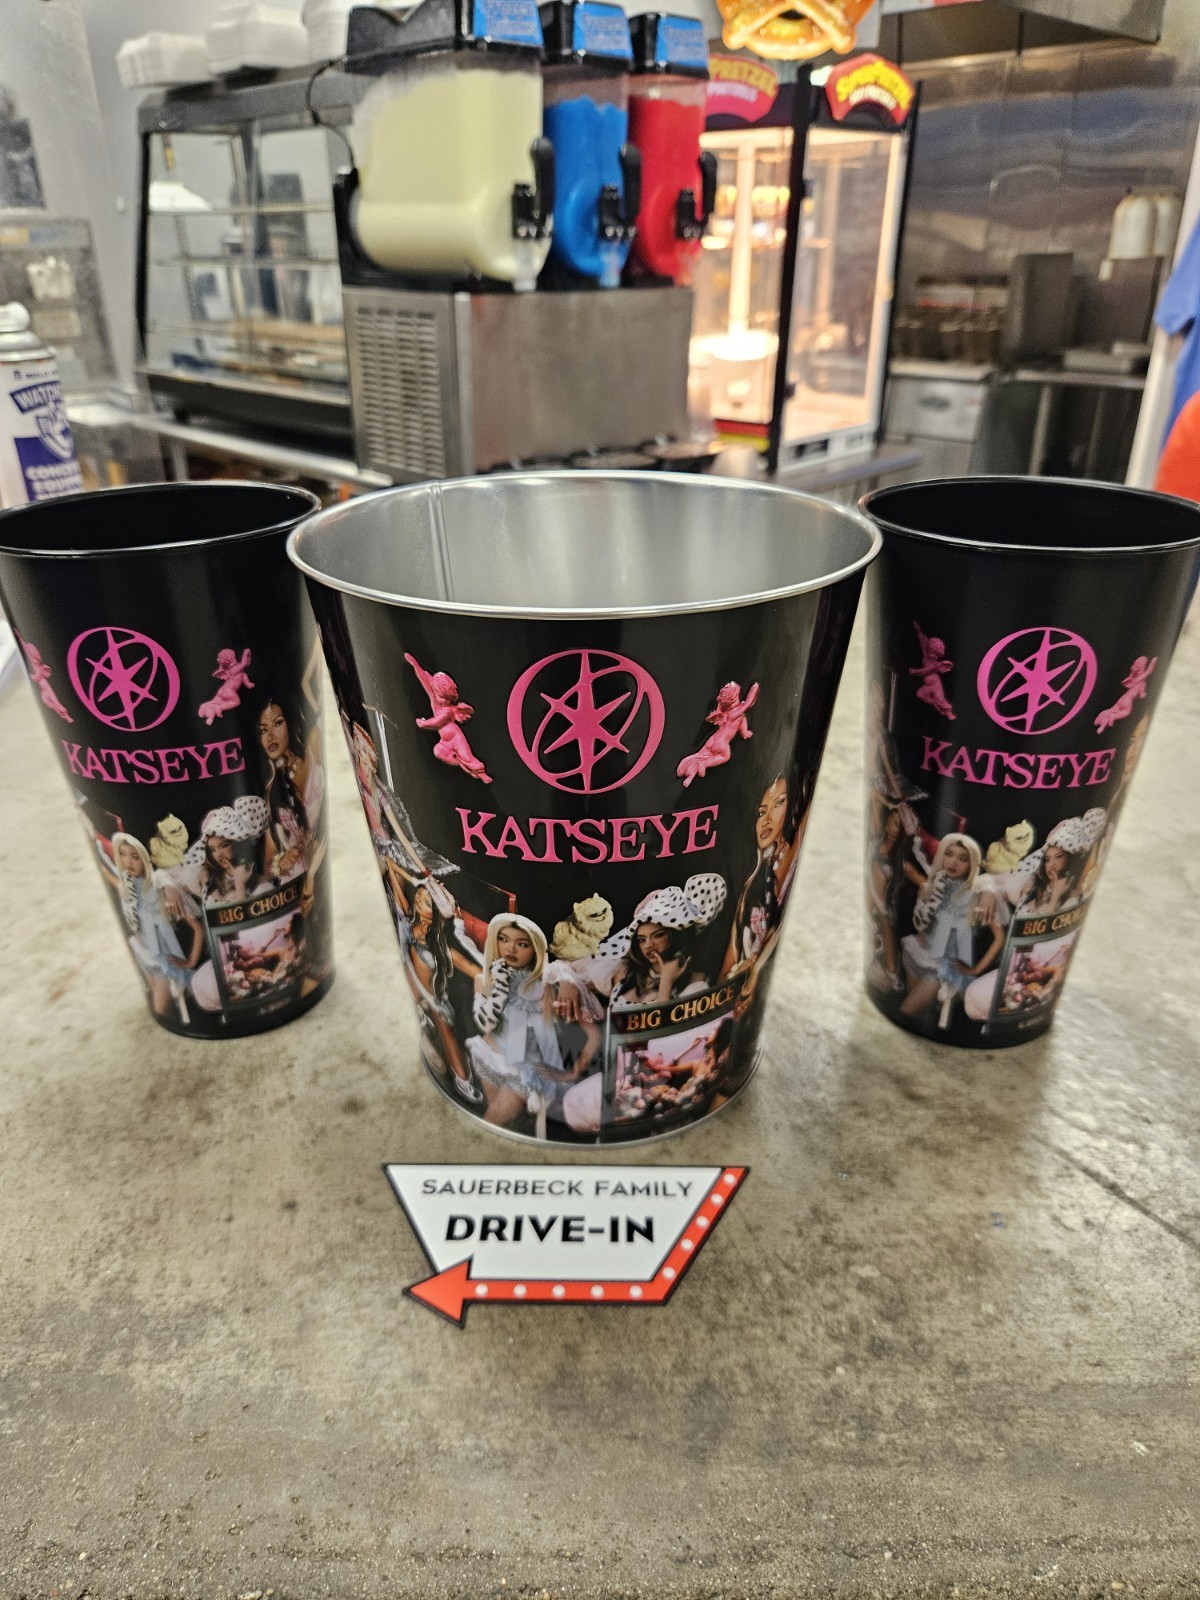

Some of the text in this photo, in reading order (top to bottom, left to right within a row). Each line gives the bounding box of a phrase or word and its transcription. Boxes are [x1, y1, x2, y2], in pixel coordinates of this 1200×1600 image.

[62, 737, 245, 784] KATSEYE
[921, 735, 1116, 789] KATSEYE
[456, 804, 719, 864] KATSEYE
[219, 886, 298, 924] BIG CHOICE
[1022, 918, 1047, 936] BIG
[626, 985, 734, 1031] BIG CHOICE
[422, 1179, 693, 1198] SAUERBECK FAMILY
[445, 1214, 655, 1244] DRIVE-IN
